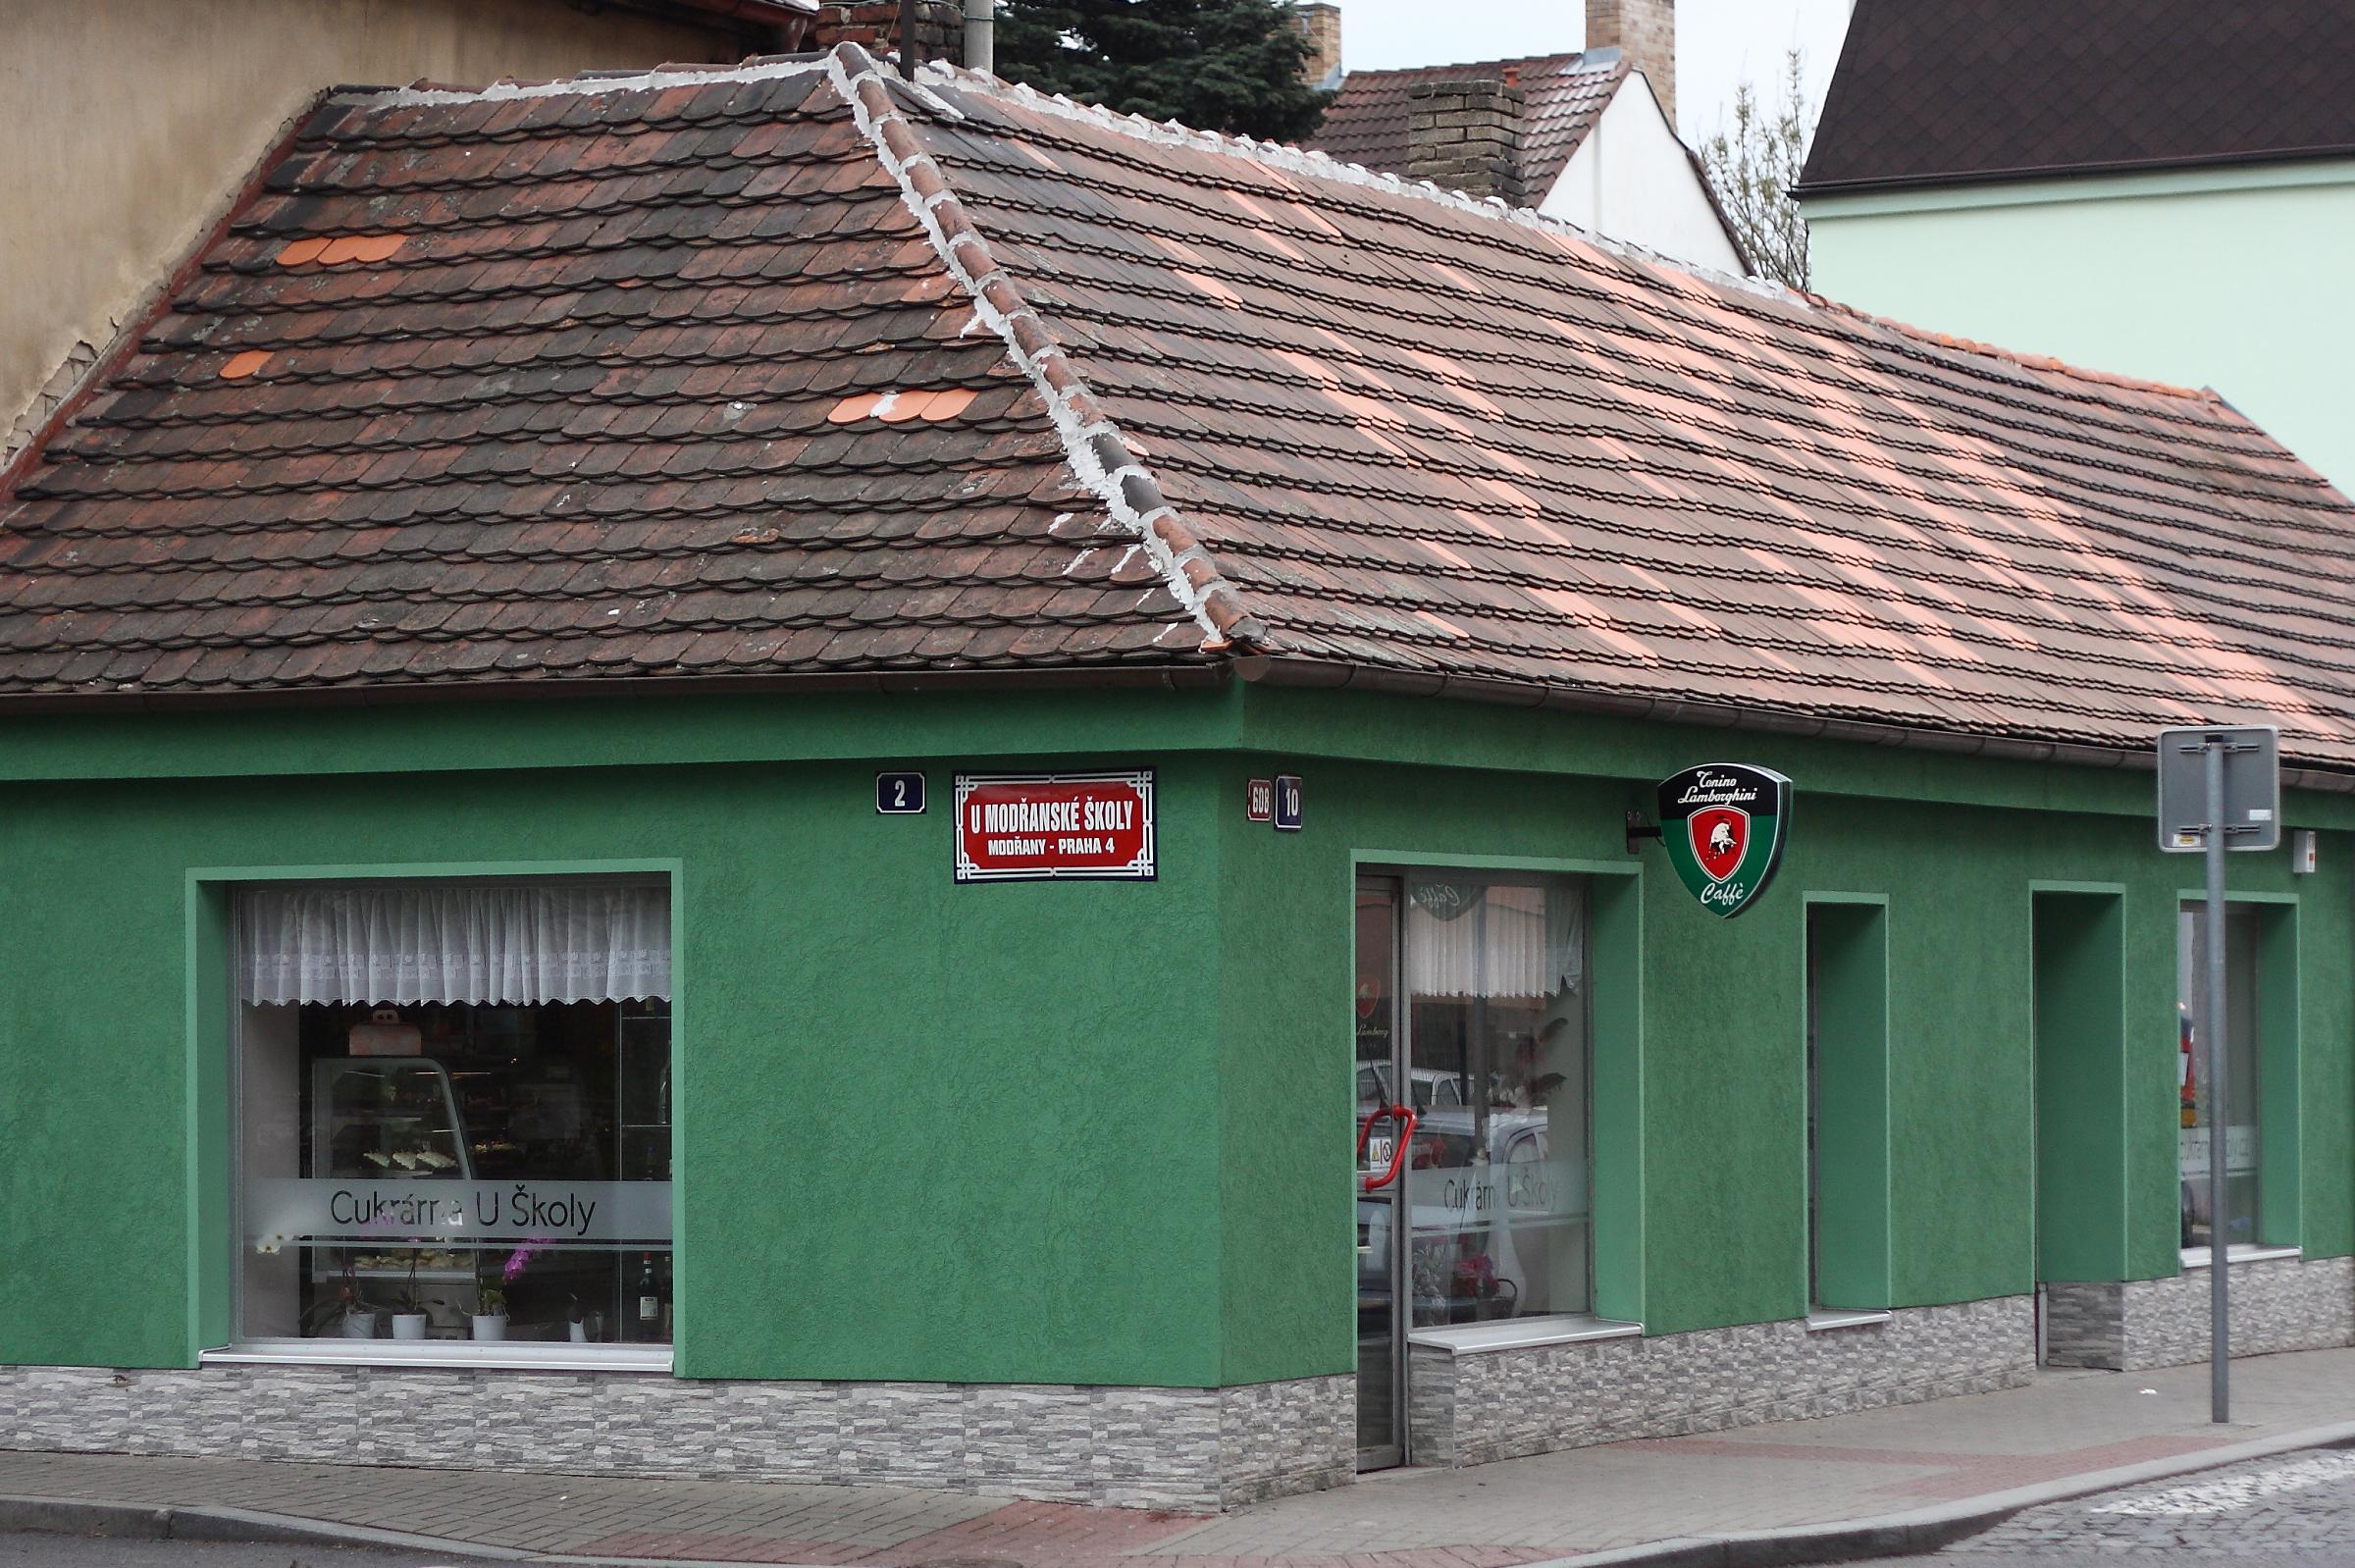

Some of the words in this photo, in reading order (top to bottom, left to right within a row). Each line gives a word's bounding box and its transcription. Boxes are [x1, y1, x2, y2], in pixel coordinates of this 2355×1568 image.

[1697, 770, 1737, 788] Tonino
[895, 780, 906, 807] 2
[1252, 787, 1270, 813] 608
[1285, 788, 1298, 816] 10
[1678, 786, 1757, 808] Lamborghini
[970, 805, 980, 833] U
[985, 797, 1079, 833] MODŘANSKÉ
[1084, 796, 1133, 830] ŠKOLY
[988, 836, 1046, 856] MODŘANY
[1059, 838, 1102, 854] PRAHA
[1105, 837, 1115, 854] 4
[1701, 882, 1744, 906] Caffè
[477, 1192, 498, 1227] U
[511, 1184, 596, 1236] Školy
